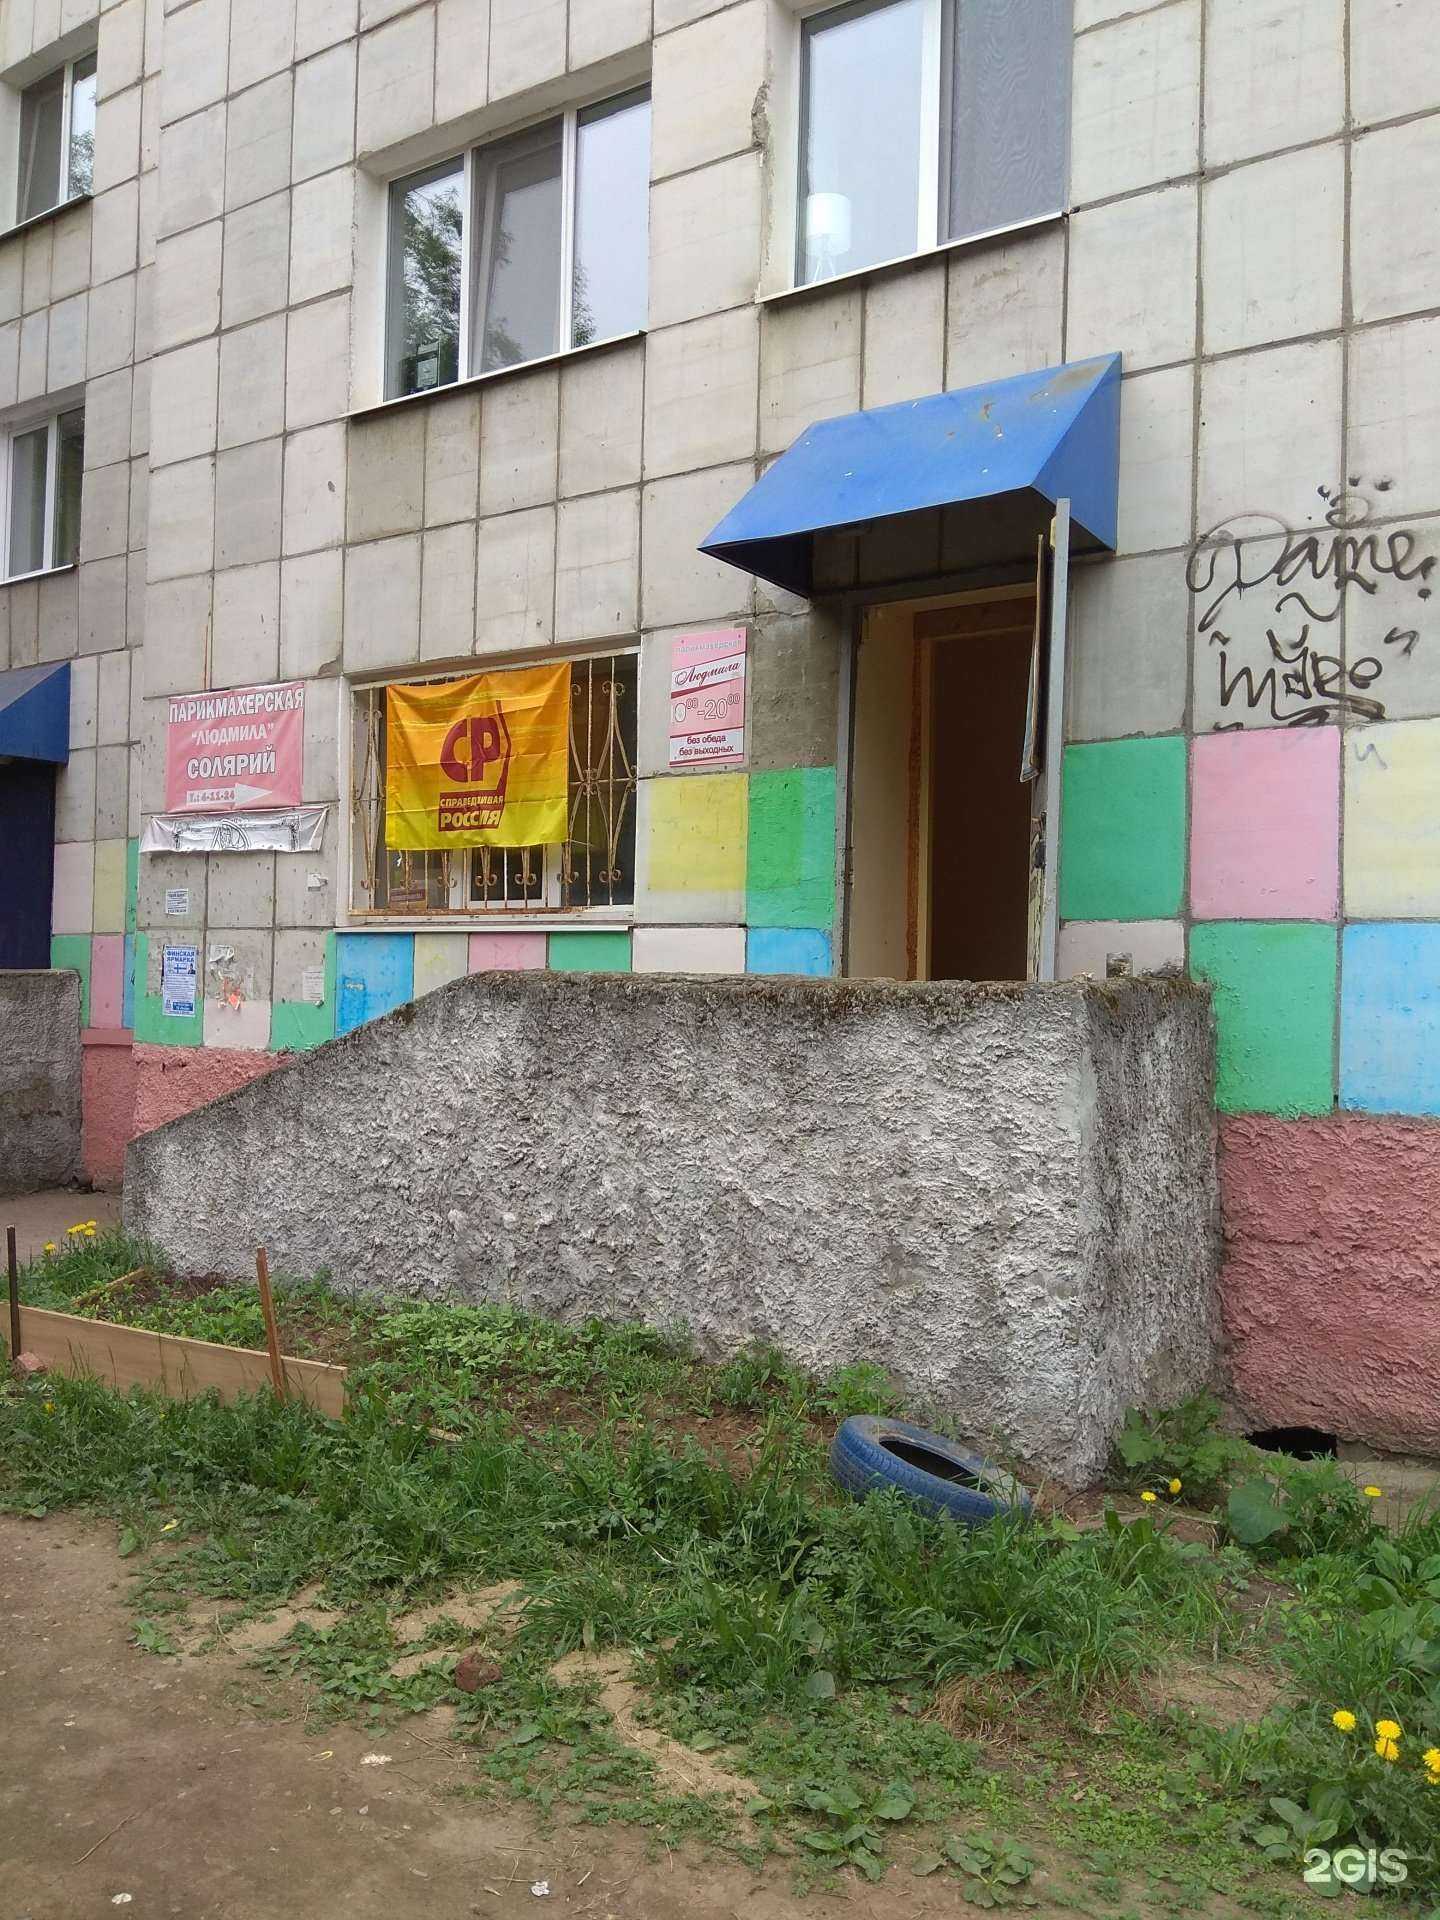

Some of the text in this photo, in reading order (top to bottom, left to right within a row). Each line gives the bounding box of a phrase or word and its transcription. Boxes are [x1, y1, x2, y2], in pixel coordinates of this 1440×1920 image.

[674, 662, 742, 686] Людмила
[168, 688, 304, 723] ПАРИКМАХЕРСКАЯ
[687, 734, 727, 744] без обеда
[679, 745, 734, 756] без выходных
[187, 745, 276, 779] СОЛЯРИЙ
[440, 810, 501, 828] РОССИЯ
